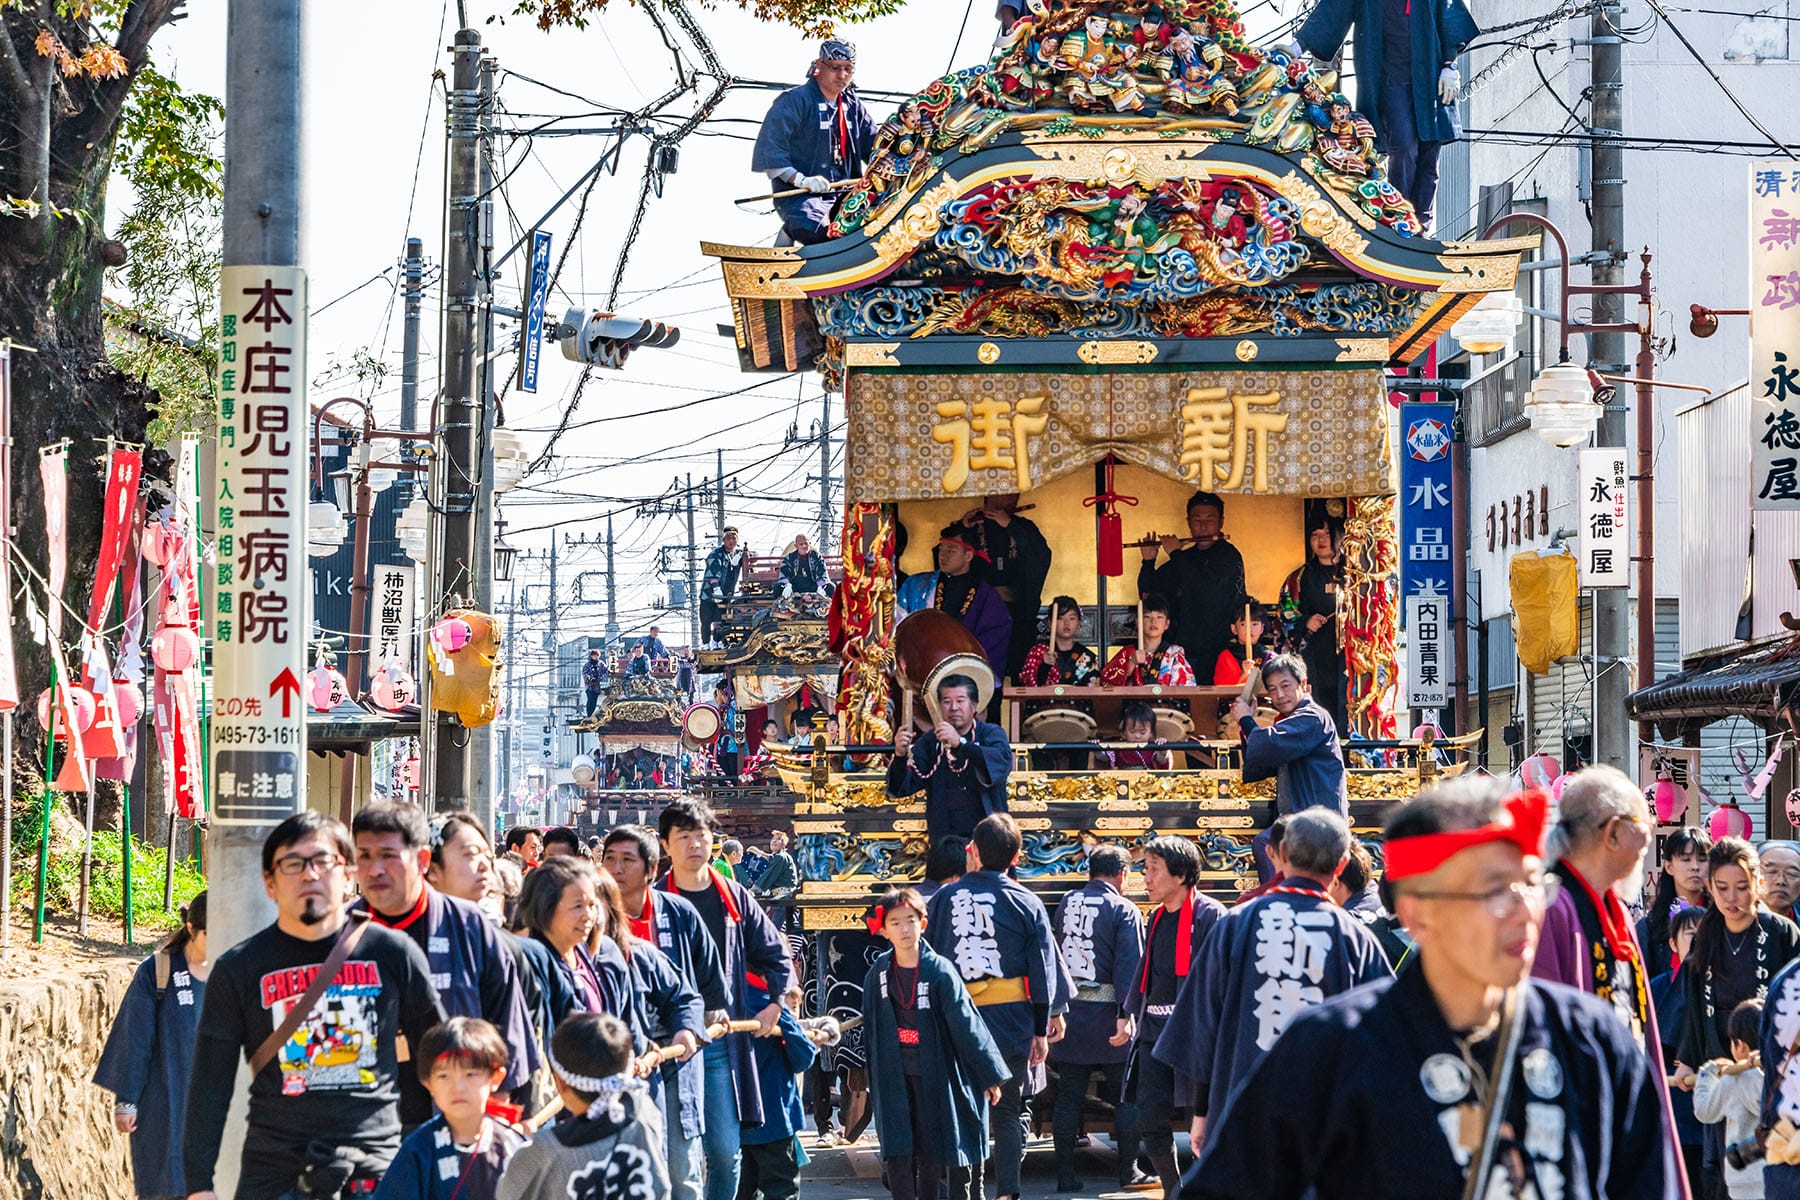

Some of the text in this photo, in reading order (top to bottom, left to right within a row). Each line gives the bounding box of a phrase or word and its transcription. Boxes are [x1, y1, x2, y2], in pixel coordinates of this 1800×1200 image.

[1758, 351, 1800, 501] 永徳屋
[1414, 433, 1445, 448] 水晶米
[240, 278, 293, 644] 本庄児玉病院
[1590, 477, 1614, 574] 永徳屋
[1418, 602, 1439, 687] 内田青果
[393, 680, 408, 703] 町
[215, 697, 262, 717] この先
[214, 725, 301, 745] 0495-73-1611
[218, 770, 294, 798] 車に注意
